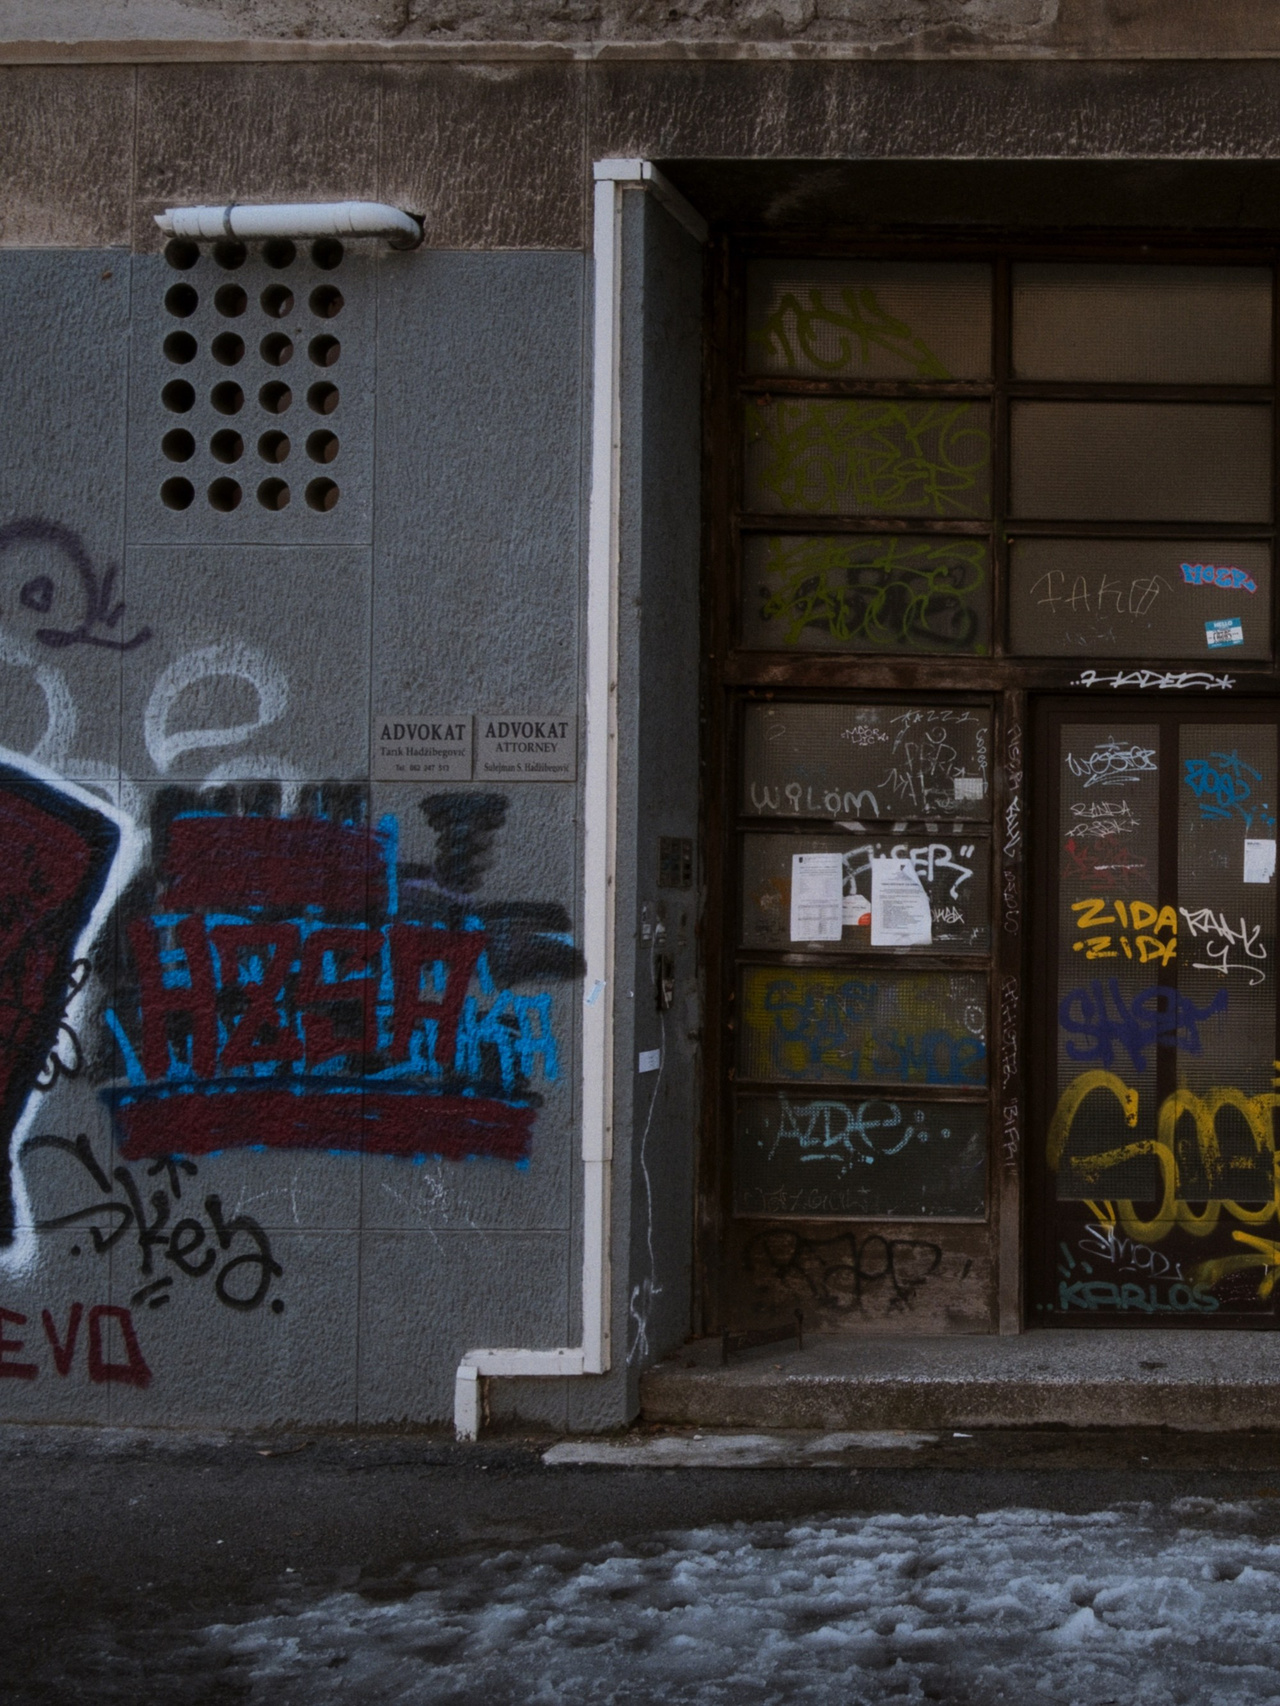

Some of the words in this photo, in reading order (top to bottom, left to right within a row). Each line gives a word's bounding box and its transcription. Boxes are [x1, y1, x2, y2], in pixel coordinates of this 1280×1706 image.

[380, 723, 466, 741] ADVOKAT
[485, 721, 569, 738] ADVOKAT
[495, 742, 558, 753] ATTORNEY
[1071, 898, 1178, 936] ZIDA
